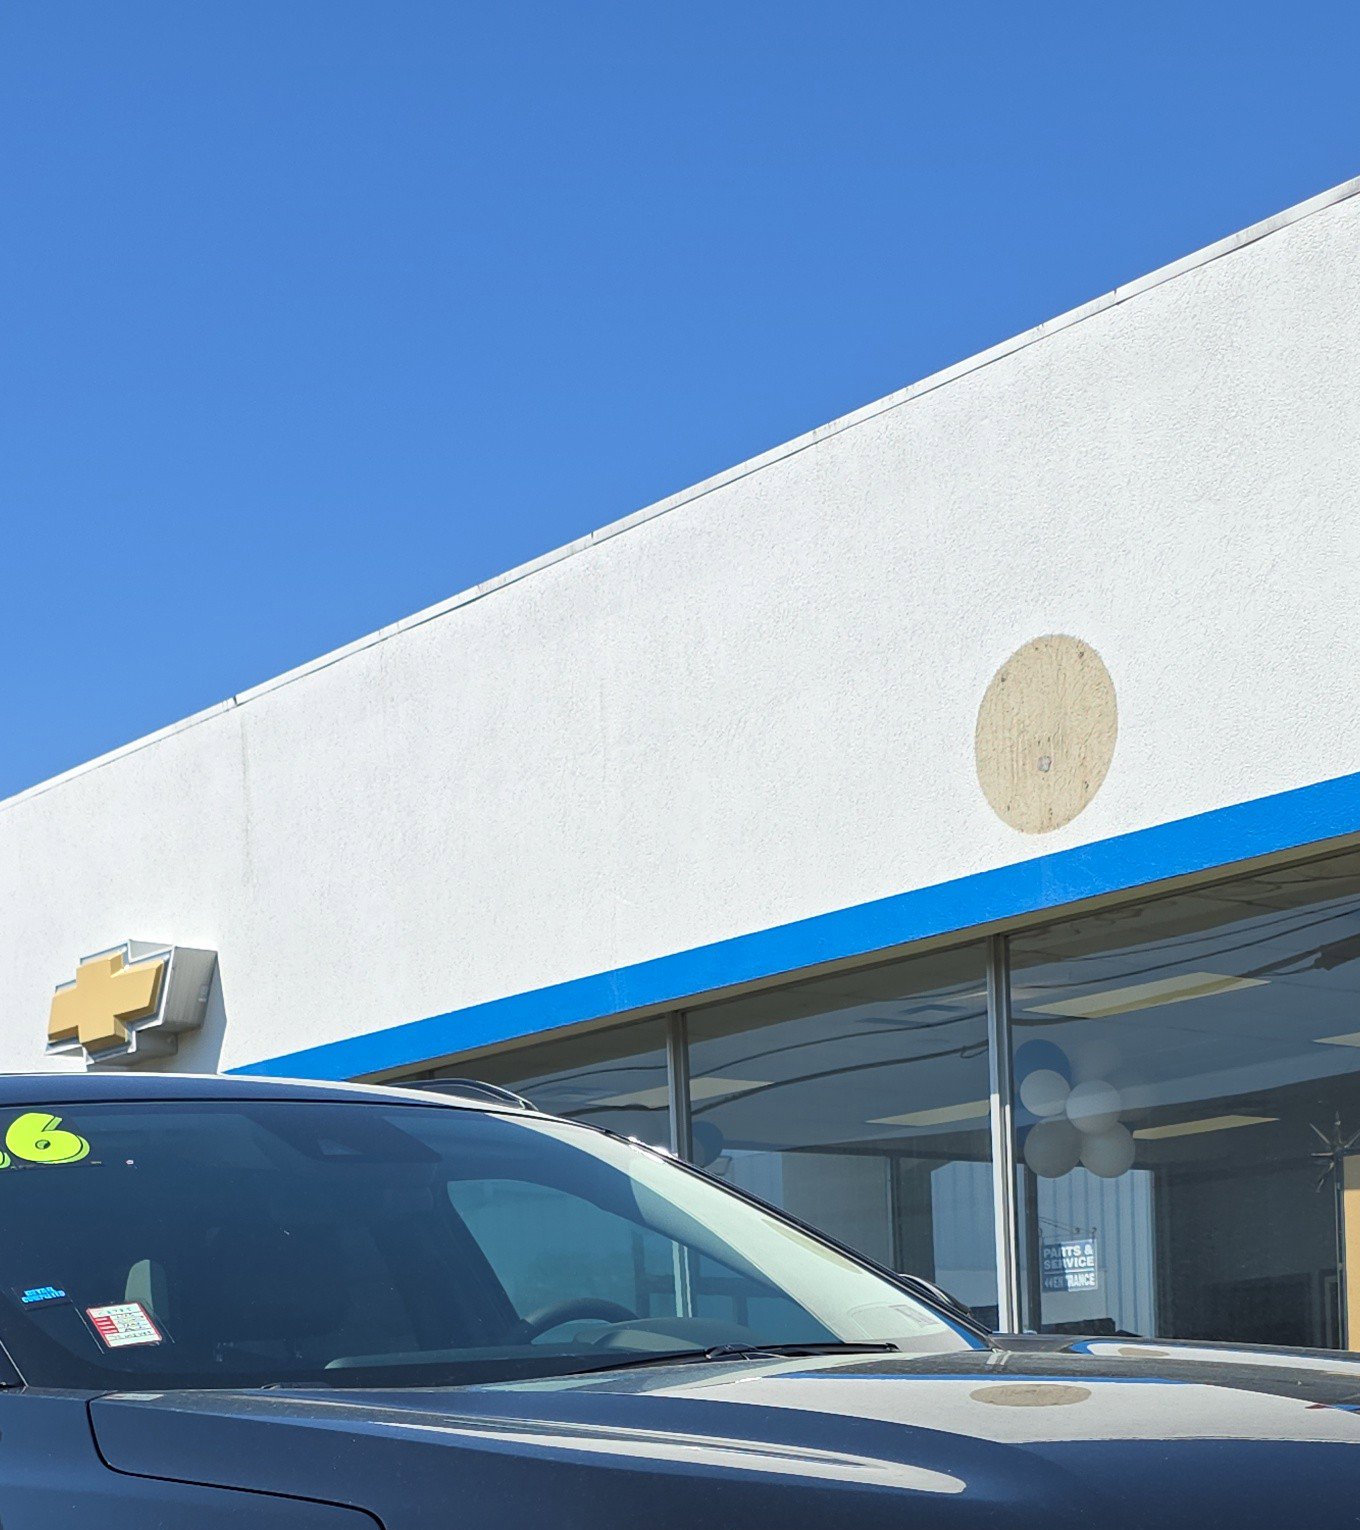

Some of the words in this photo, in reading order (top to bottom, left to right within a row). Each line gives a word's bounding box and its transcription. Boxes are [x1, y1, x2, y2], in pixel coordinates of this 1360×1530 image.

[1043, 1245, 1081, 1258] PARTS
[1084, 1244, 1093, 1255] &
[1043, 1256, 1094, 1270] SERVICE
